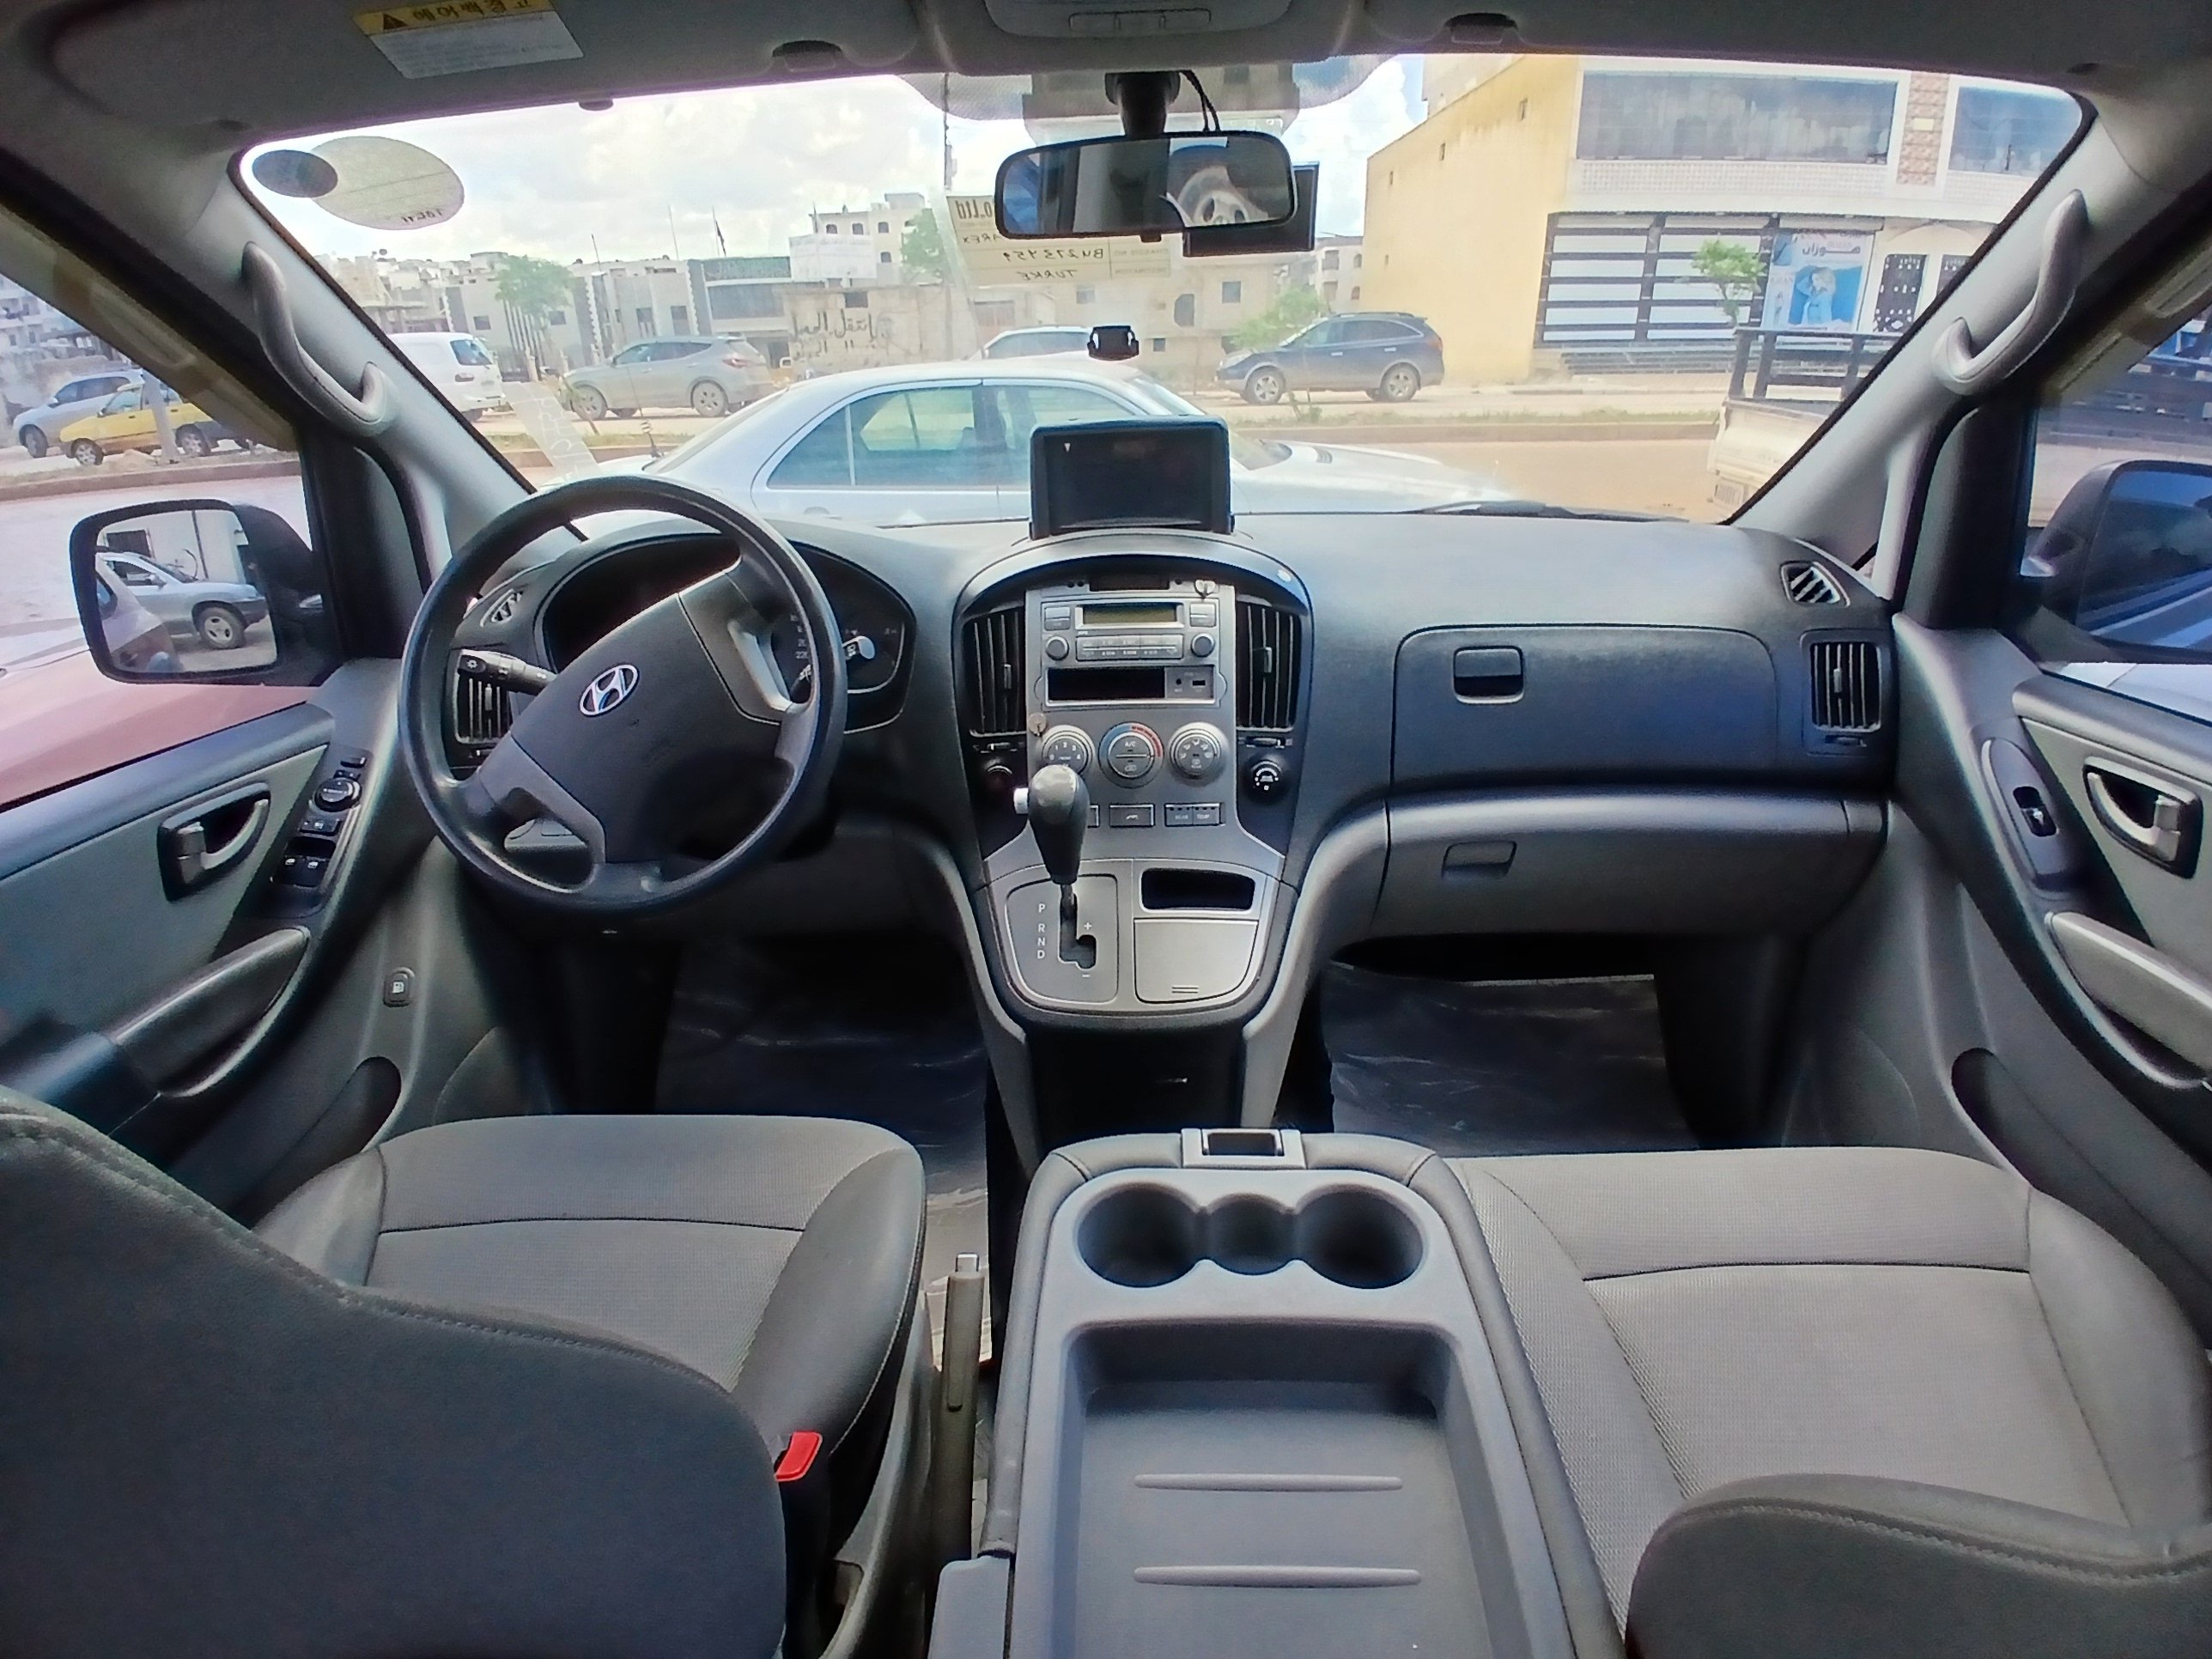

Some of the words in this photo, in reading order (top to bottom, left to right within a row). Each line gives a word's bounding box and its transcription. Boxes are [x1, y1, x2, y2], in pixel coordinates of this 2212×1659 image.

[1037, 902, 1046, 913] P
[1037, 923, 1046, 933] R
[1037, 937, 1046, 946] N
[1036, 950, 1046, 959] D
